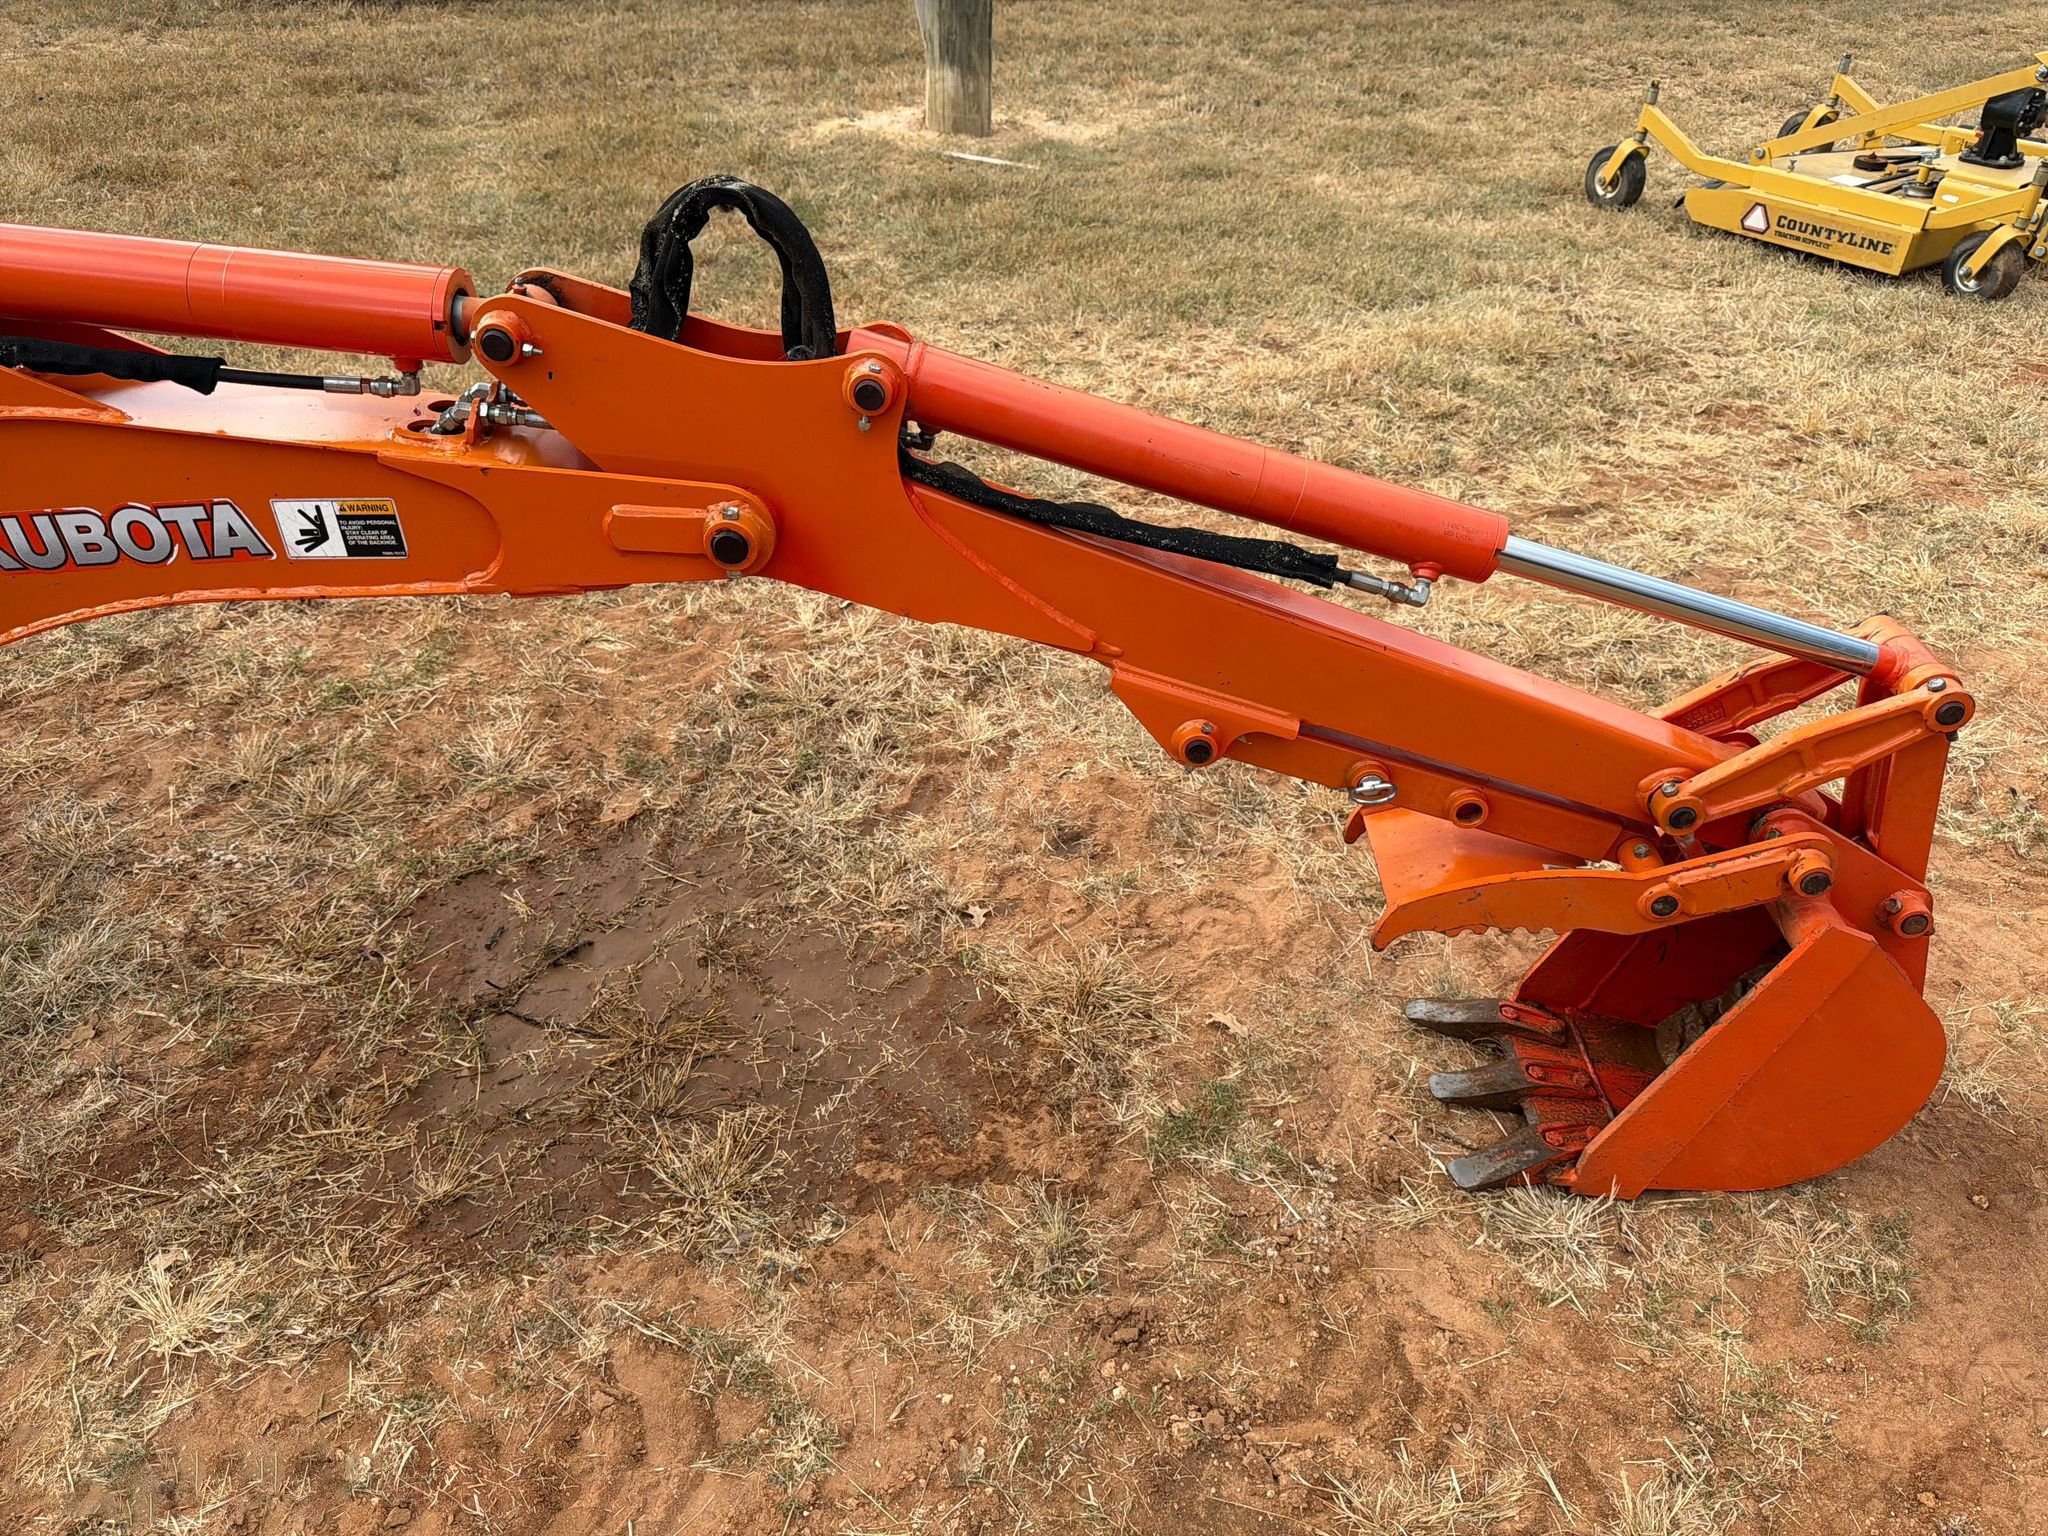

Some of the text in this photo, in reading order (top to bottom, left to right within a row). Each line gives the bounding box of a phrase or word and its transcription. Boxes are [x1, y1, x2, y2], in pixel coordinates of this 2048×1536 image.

[1774, 230, 1801, 241] TRACTOR
[1802, 237, 1822, 248] SUPPLY
[1776, 215, 1893, 255] COUNTYLINE
[347, 504, 389, 512] WARNING
